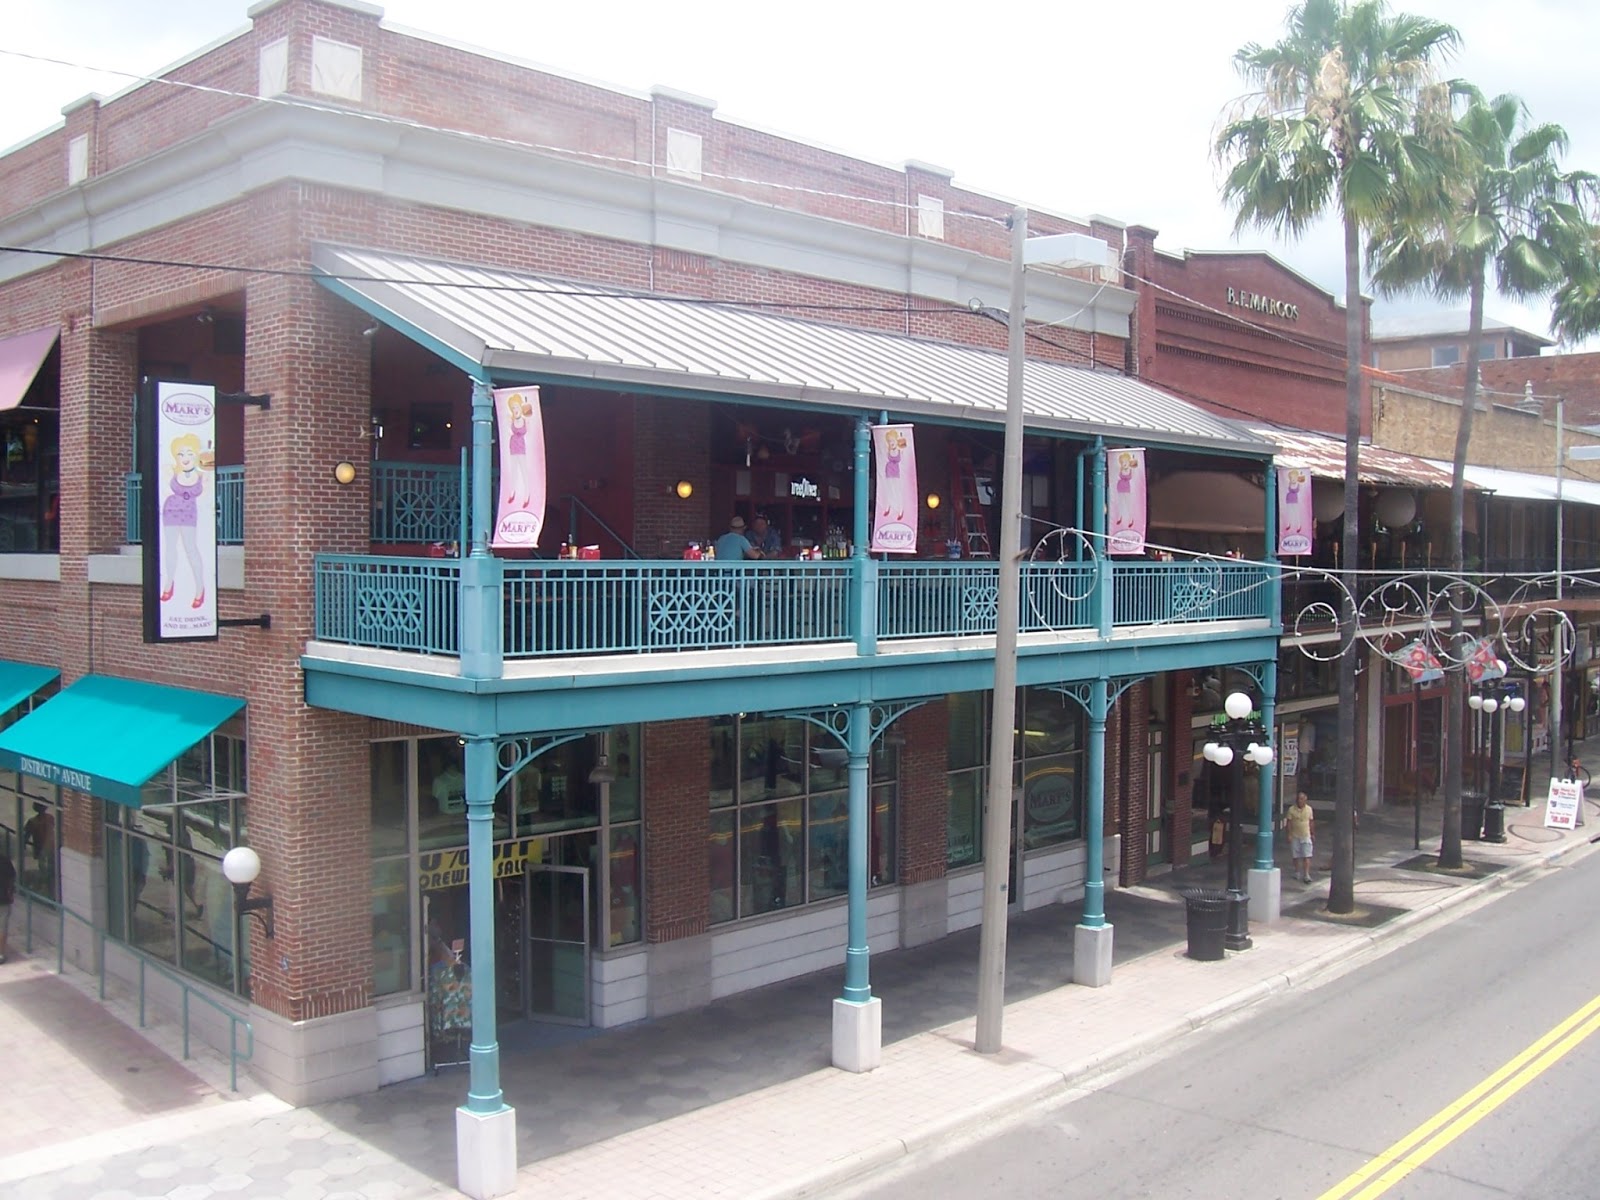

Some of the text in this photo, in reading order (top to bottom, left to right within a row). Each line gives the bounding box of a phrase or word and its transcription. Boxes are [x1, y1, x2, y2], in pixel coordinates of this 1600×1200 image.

[165, 402, 211, 416] MARY'S
[501, 521, 536, 532] MARY'S
[21, 757, 51, 779] DISTRICT
[62, 769, 92, 791] AVENUE
